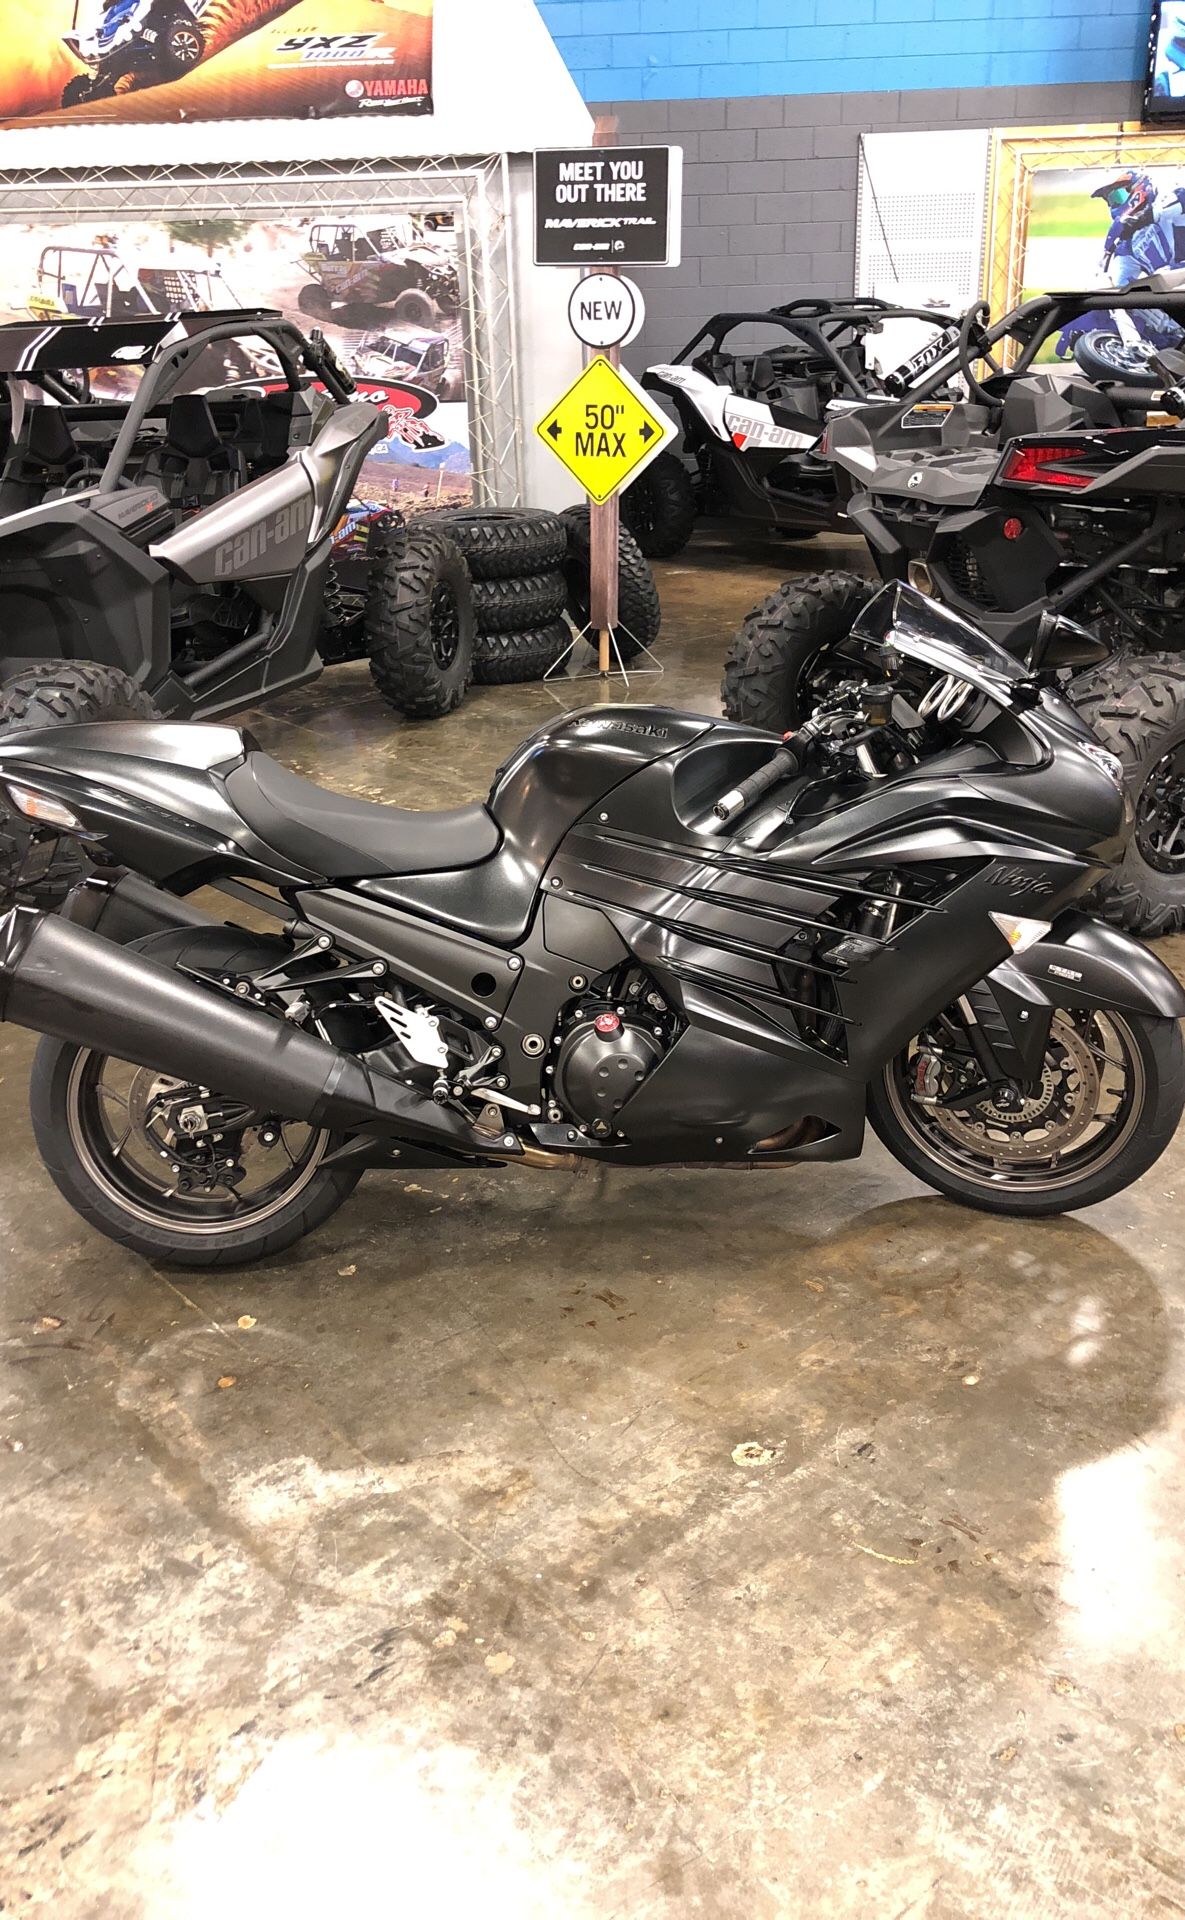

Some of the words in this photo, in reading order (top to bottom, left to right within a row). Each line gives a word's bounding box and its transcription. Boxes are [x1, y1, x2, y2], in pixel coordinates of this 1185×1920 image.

[364, 79, 428, 96] YAMAHA
[559, 162, 605, 181] MEET
[609, 160, 644, 180] YOU
[555, 184, 589, 203] OUT
[594, 183, 647, 202] THERE
[544, 218, 621, 228] MAVERICK
[580, 300, 622, 321] NEW
[911, 337, 946, 370] FOX
[585, 404, 625, 430] 50"
[727, 414, 804, 448] can-am
[575, 432, 627, 457] MAX
[214, 494, 313, 576] can-am
[568, 717, 669, 739] Kawasaki
[984, 865, 1054, 897] Ninja
